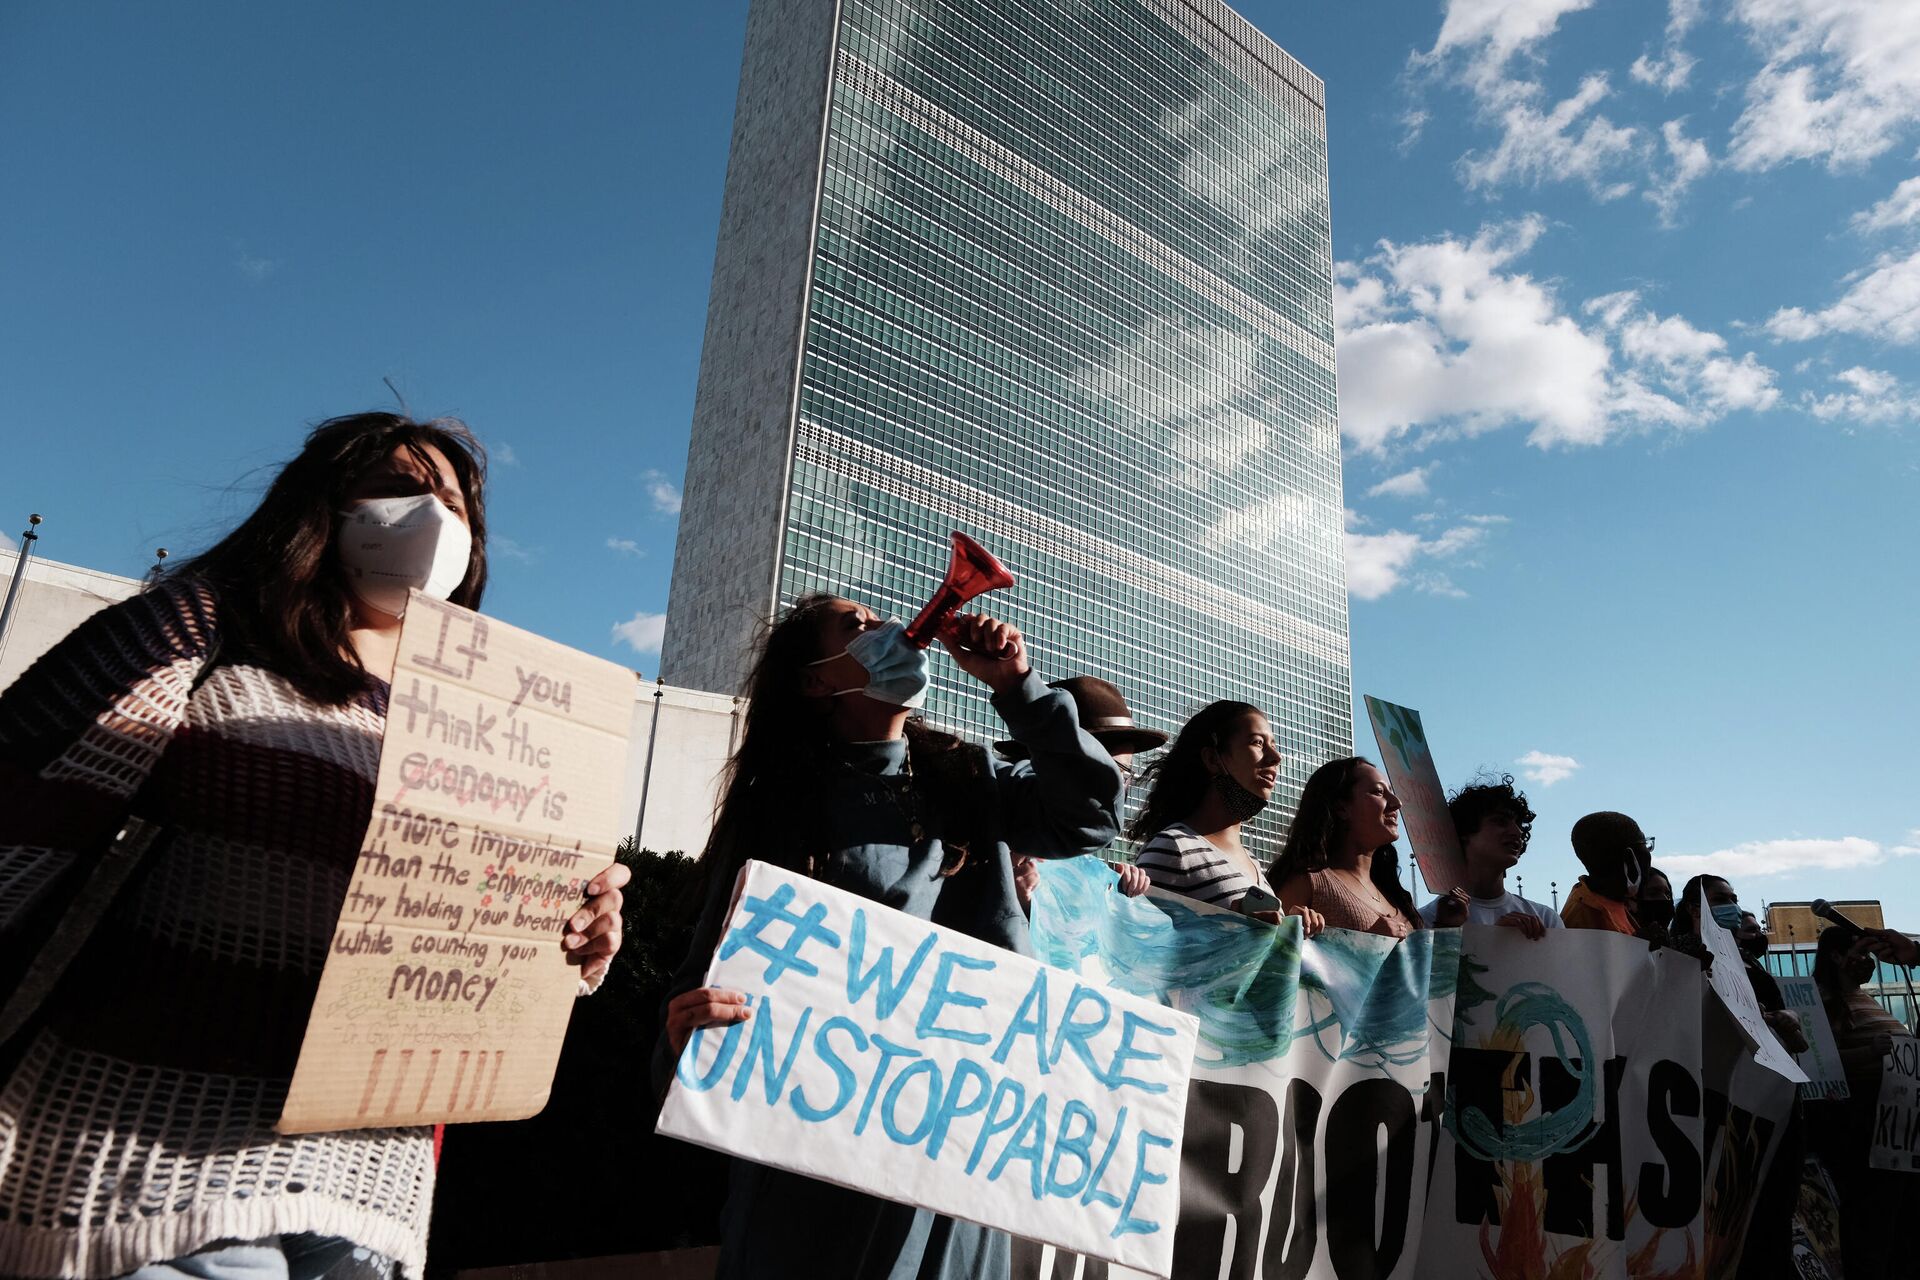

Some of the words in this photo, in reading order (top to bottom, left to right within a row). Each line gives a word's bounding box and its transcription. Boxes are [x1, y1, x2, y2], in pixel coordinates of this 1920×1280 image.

[411, 595, 489, 681] If
[506, 665, 572, 718] you
[394, 678, 497, 756] think
[502, 717, 552, 769] the
[399, 752, 538, 823] economy
[541, 788, 568, 822] is
[359, 838, 423, 879] than
[429, 852, 471, 885] the
[486, 872, 585, 902] environmen
[376, 803, 460, 850] more
[470, 825, 584, 871] important
[349, 881, 387, 925] try
[394, 882, 464, 931] holding
[468, 906, 509, 933] your
[334, 924, 394, 956] while
[411, 932, 489, 968] counting
[498, 943, 539, 968] your
[719, 883, 996, 1045] #WE
[991, 966, 1177, 1097] ARE
[674, 985, 1174, 1239] UNSTOPPABLE
